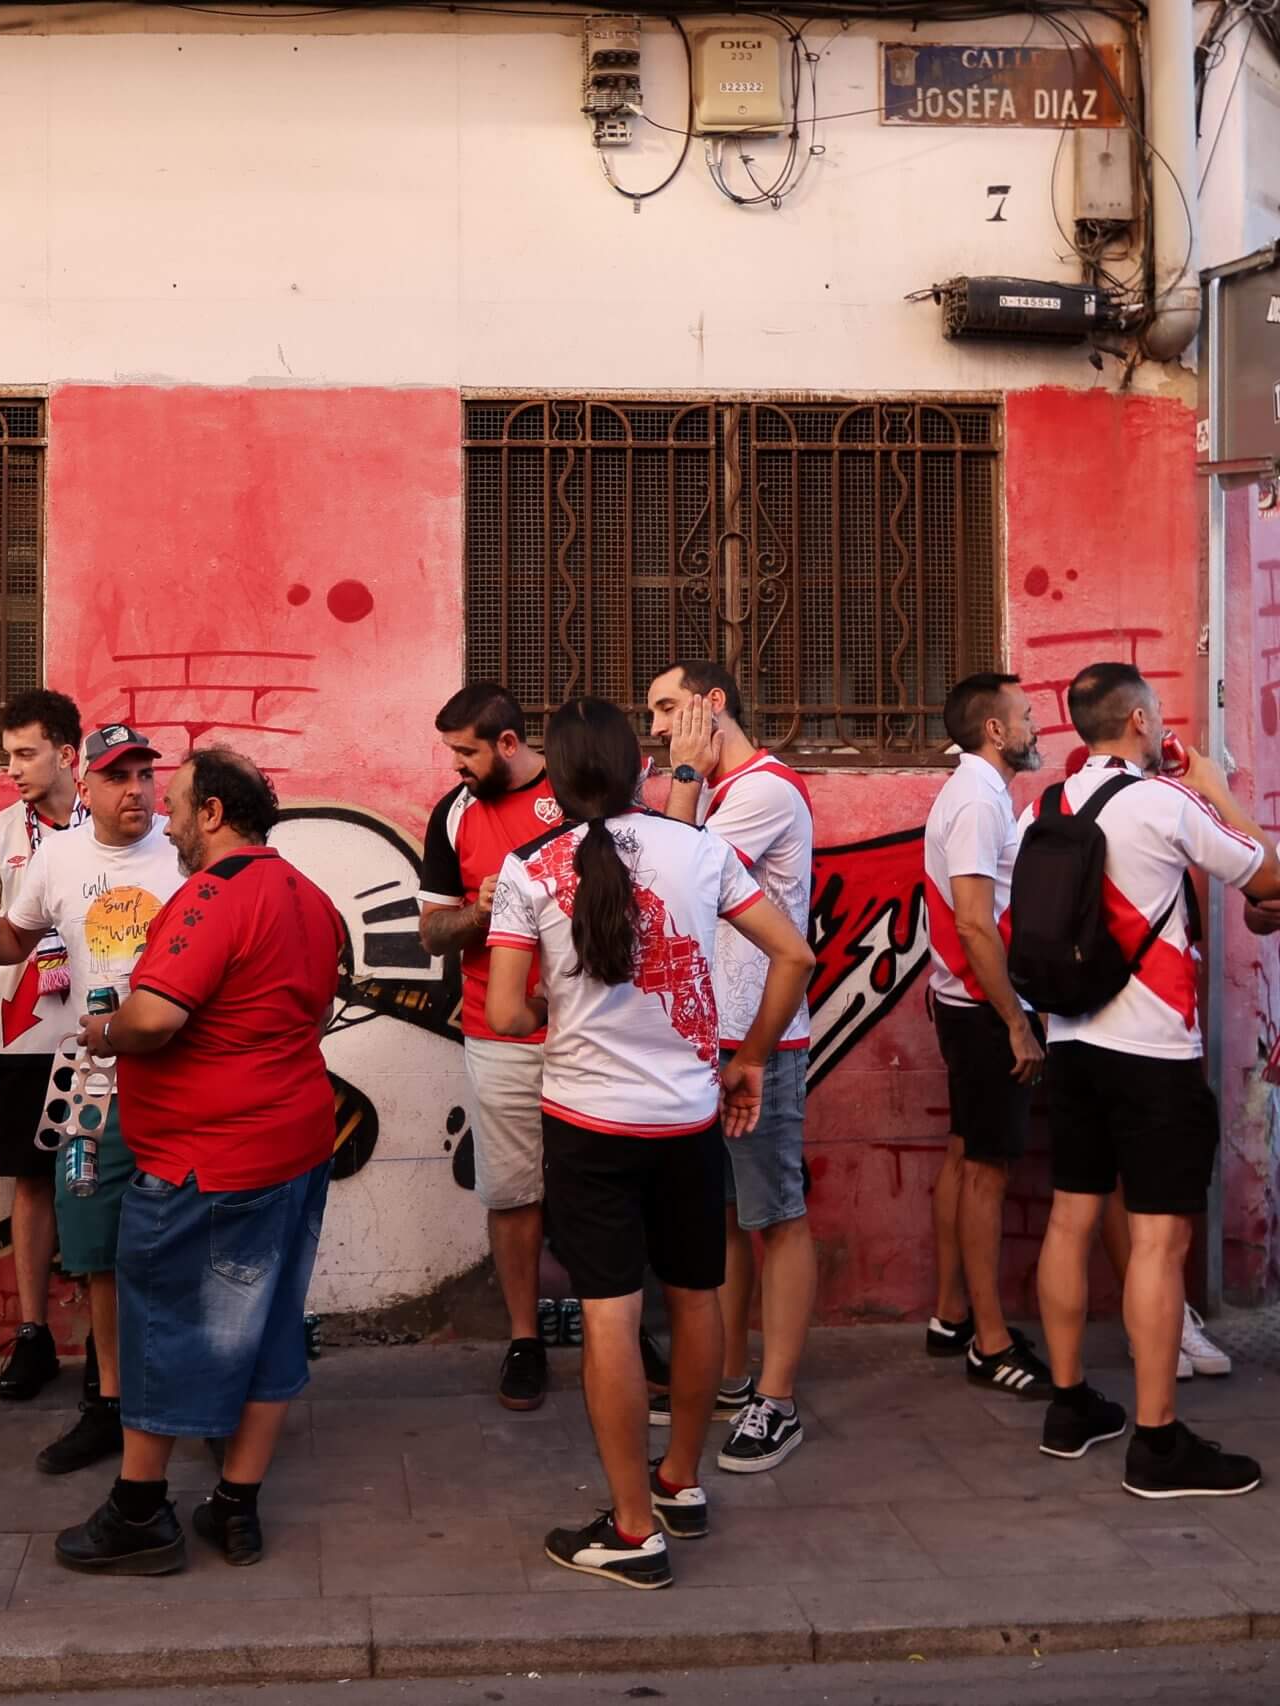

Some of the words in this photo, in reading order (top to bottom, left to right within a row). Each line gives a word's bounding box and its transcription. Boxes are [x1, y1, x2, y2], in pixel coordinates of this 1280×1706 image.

[720, 40, 763, 50] DIGI
[1034, 89, 1098, 120] DIAZ
[985, 185, 1012, 222] 7
